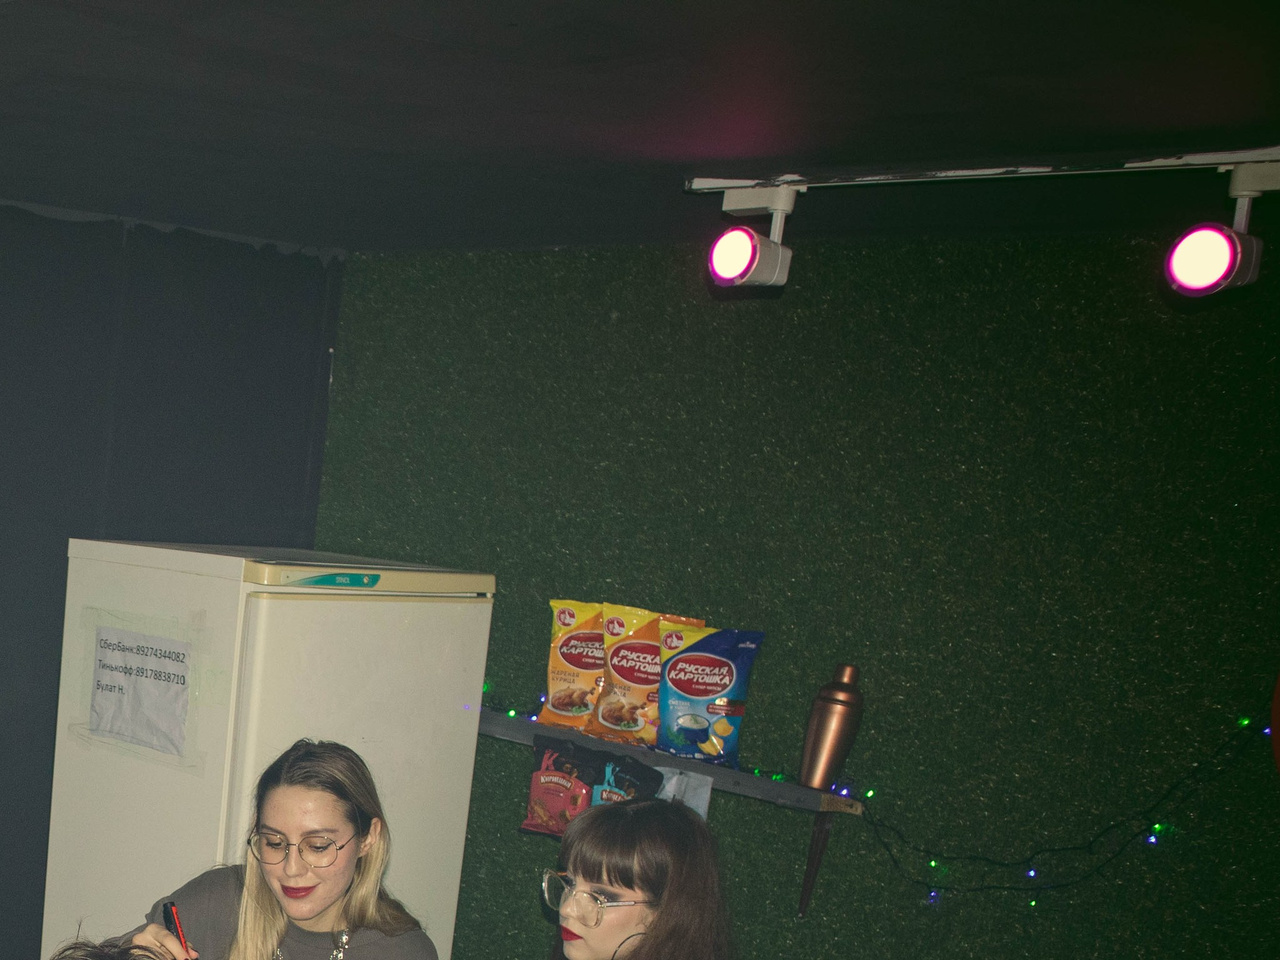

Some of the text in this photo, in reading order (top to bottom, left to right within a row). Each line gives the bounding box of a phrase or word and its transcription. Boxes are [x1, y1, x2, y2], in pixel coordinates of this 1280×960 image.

[569, 640, 604, 649] РУССК
[676, 662, 728, 675] РУССКАЯ
[669, 670, 731, 685] КАРТОШКА
[96, 680, 116, 693] Булат
